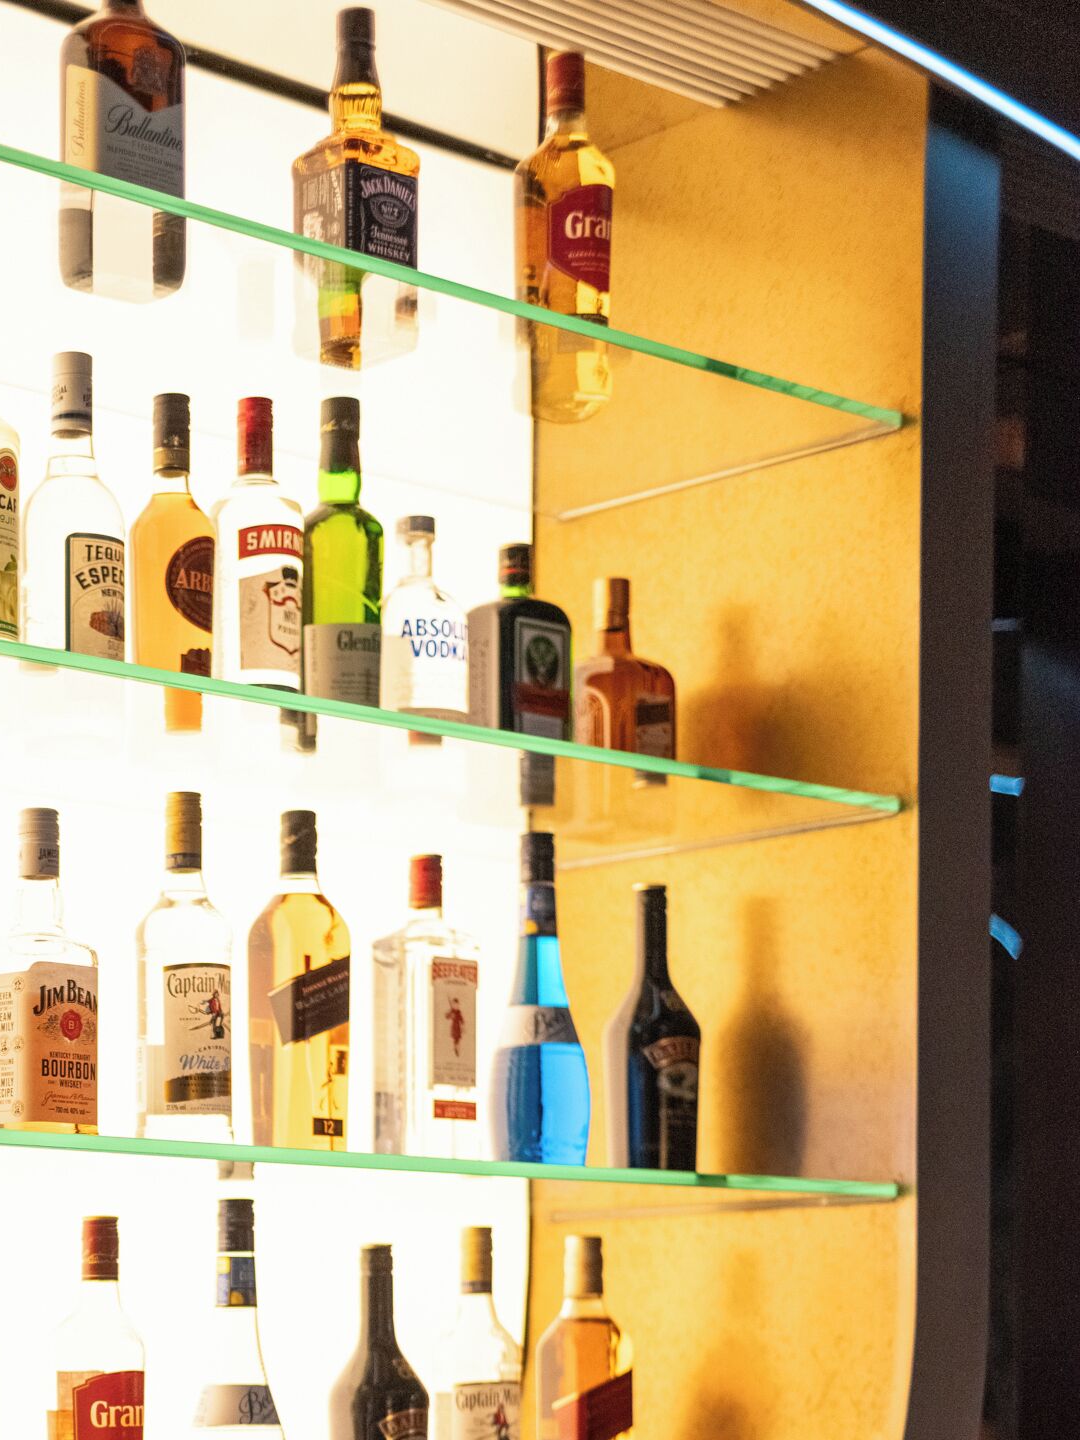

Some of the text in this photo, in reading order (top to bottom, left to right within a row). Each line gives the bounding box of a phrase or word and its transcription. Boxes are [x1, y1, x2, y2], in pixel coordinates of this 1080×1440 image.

[360, 178, 383, 199] JACK
[368, 243, 410, 261] WHISKEY
[247, 529, 302, 555] SMIRN
[85, 545, 123, 563] TEQU
[175, 567, 213, 593] ARB
[167, 973, 215, 998] Captain
[32, 985, 64, 1017] JIM
[49, 1051, 91, 1061] KENTUCKY STRAIGHT
[180, 1054, 220, 1071] White
[41, 1058, 96, 1081] BOURBON
[59, 1079, 82, 1089] WHISKEY
[323, 1120, 335, 1134] 12
[456, 1388, 500, 1410] Captain
